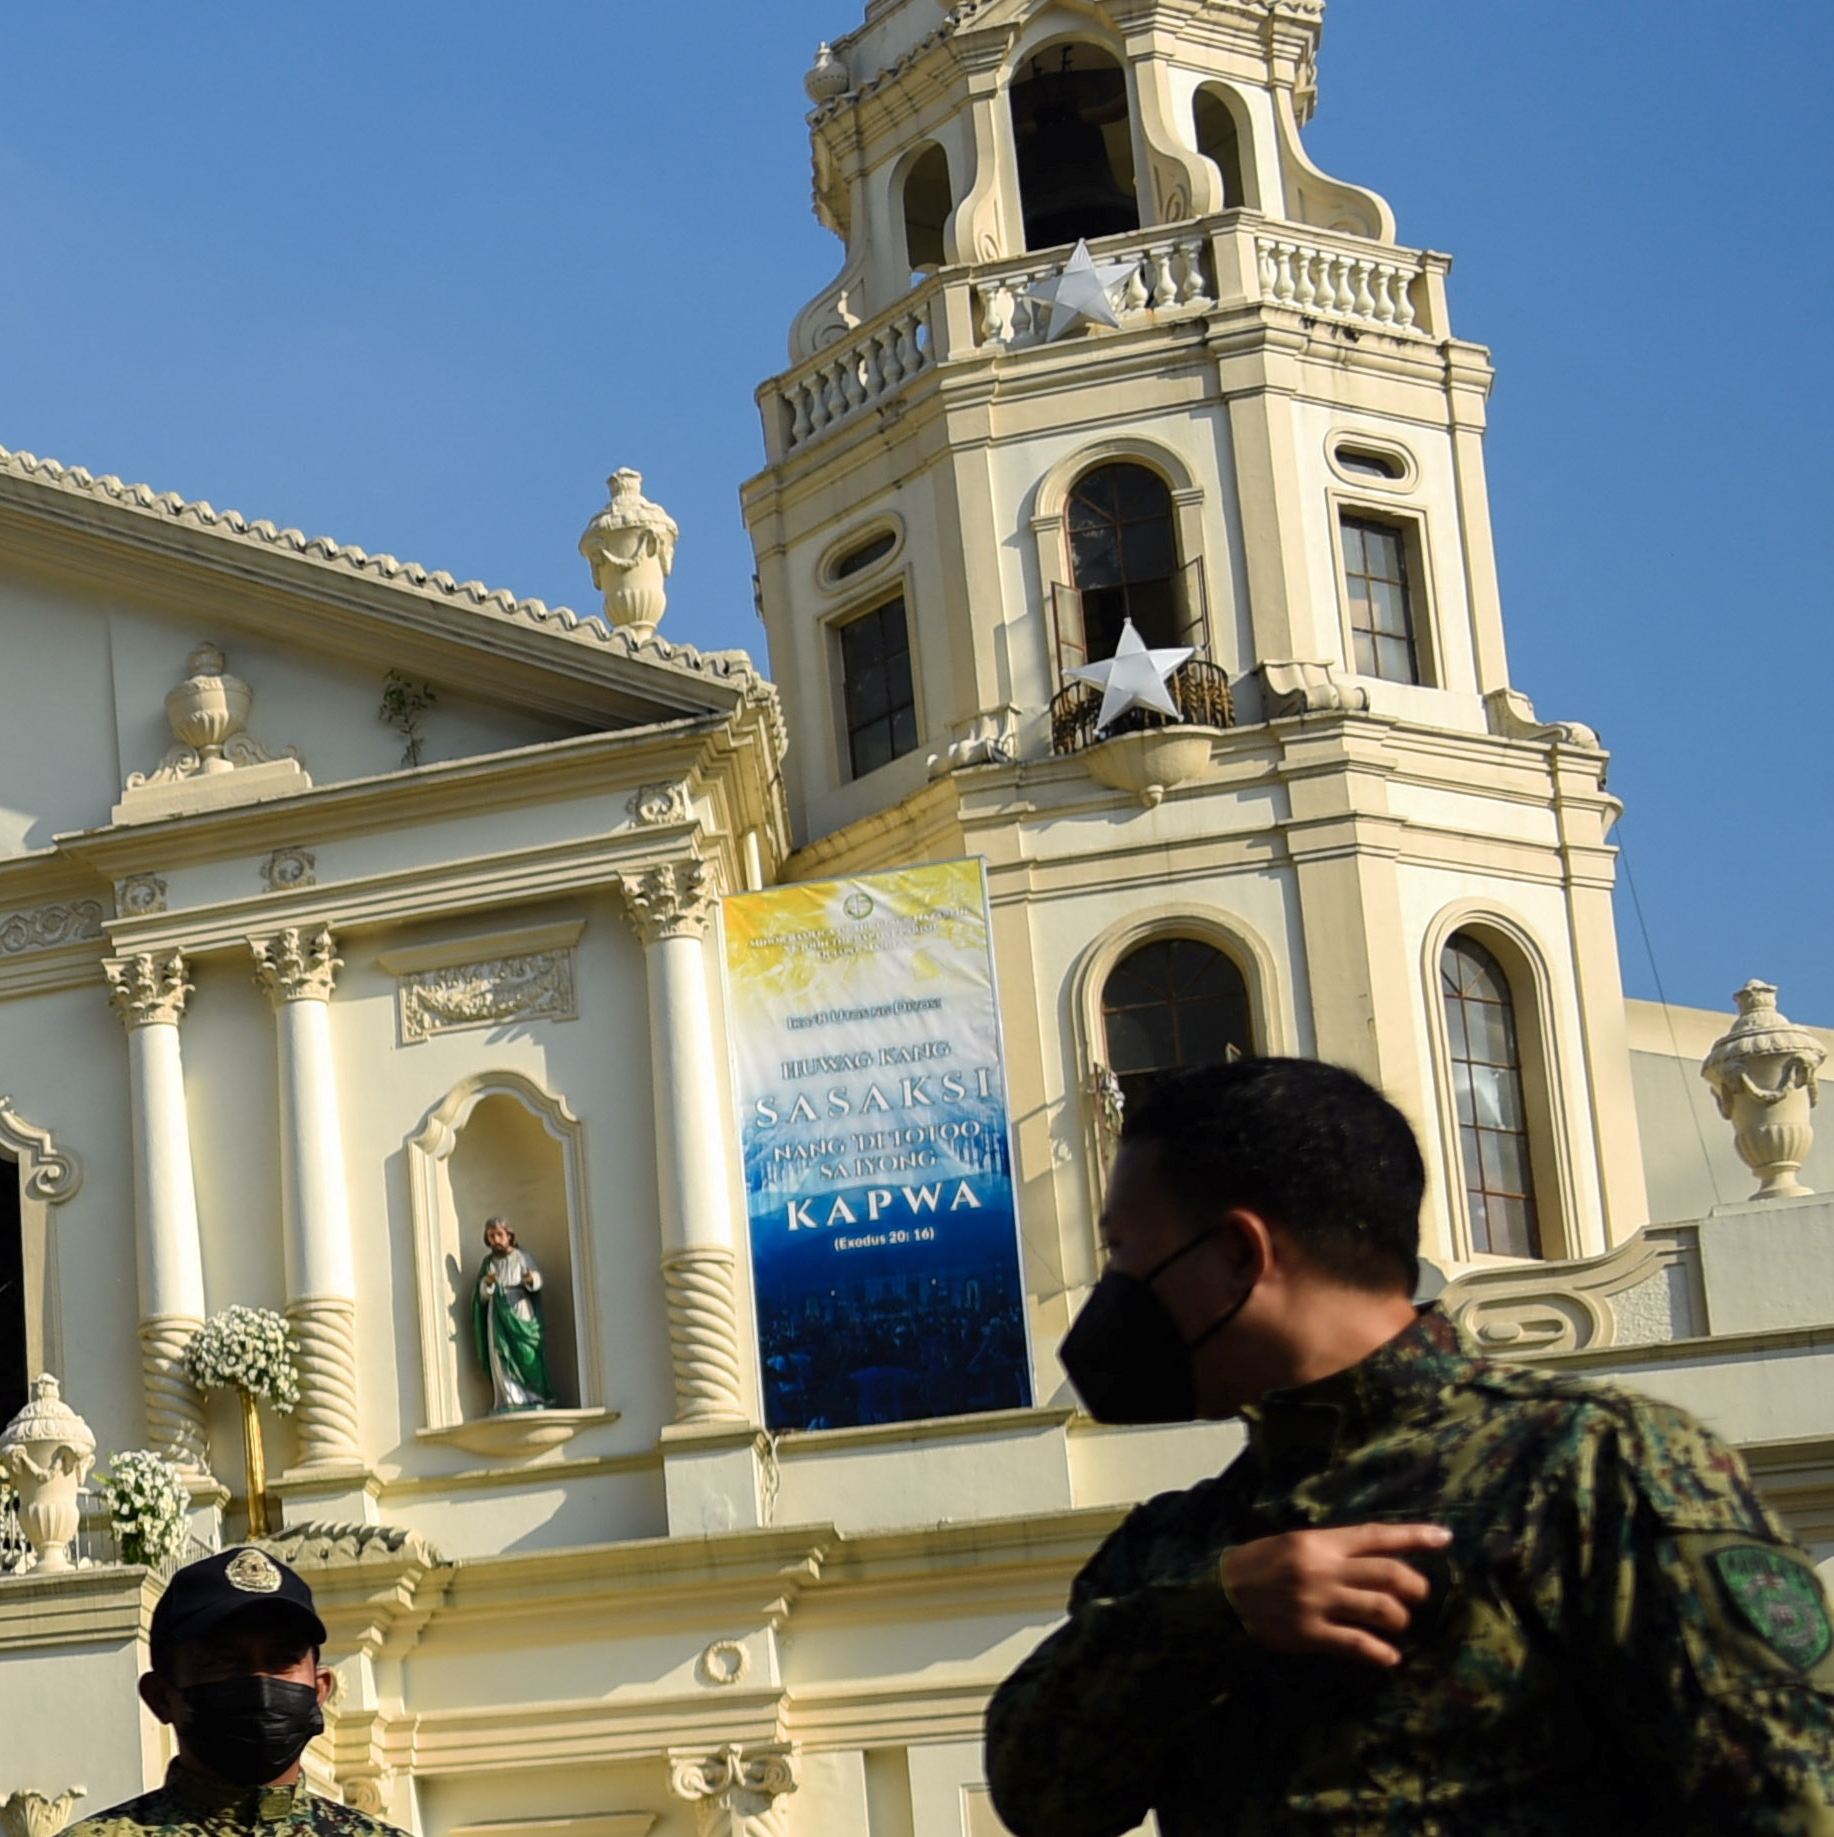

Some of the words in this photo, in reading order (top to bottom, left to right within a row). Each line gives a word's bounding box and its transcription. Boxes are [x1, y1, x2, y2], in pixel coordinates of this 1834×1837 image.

[782, 1052, 872, 1079] HUWAG
[879, 1041, 951, 1066] KANG
[755, 1067, 991, 1128] SASAKSI
[774, 1138, 846, 1163] NANG
[889, 1120, 981, 1146] TOTOO
[820, 1163, 850, 1180] SA
[855, 1150, 937, 1177] IYONG
[787, 1179, 982, 1231] KAPWA
[834, 1231, 885, 1251] (Exodus
